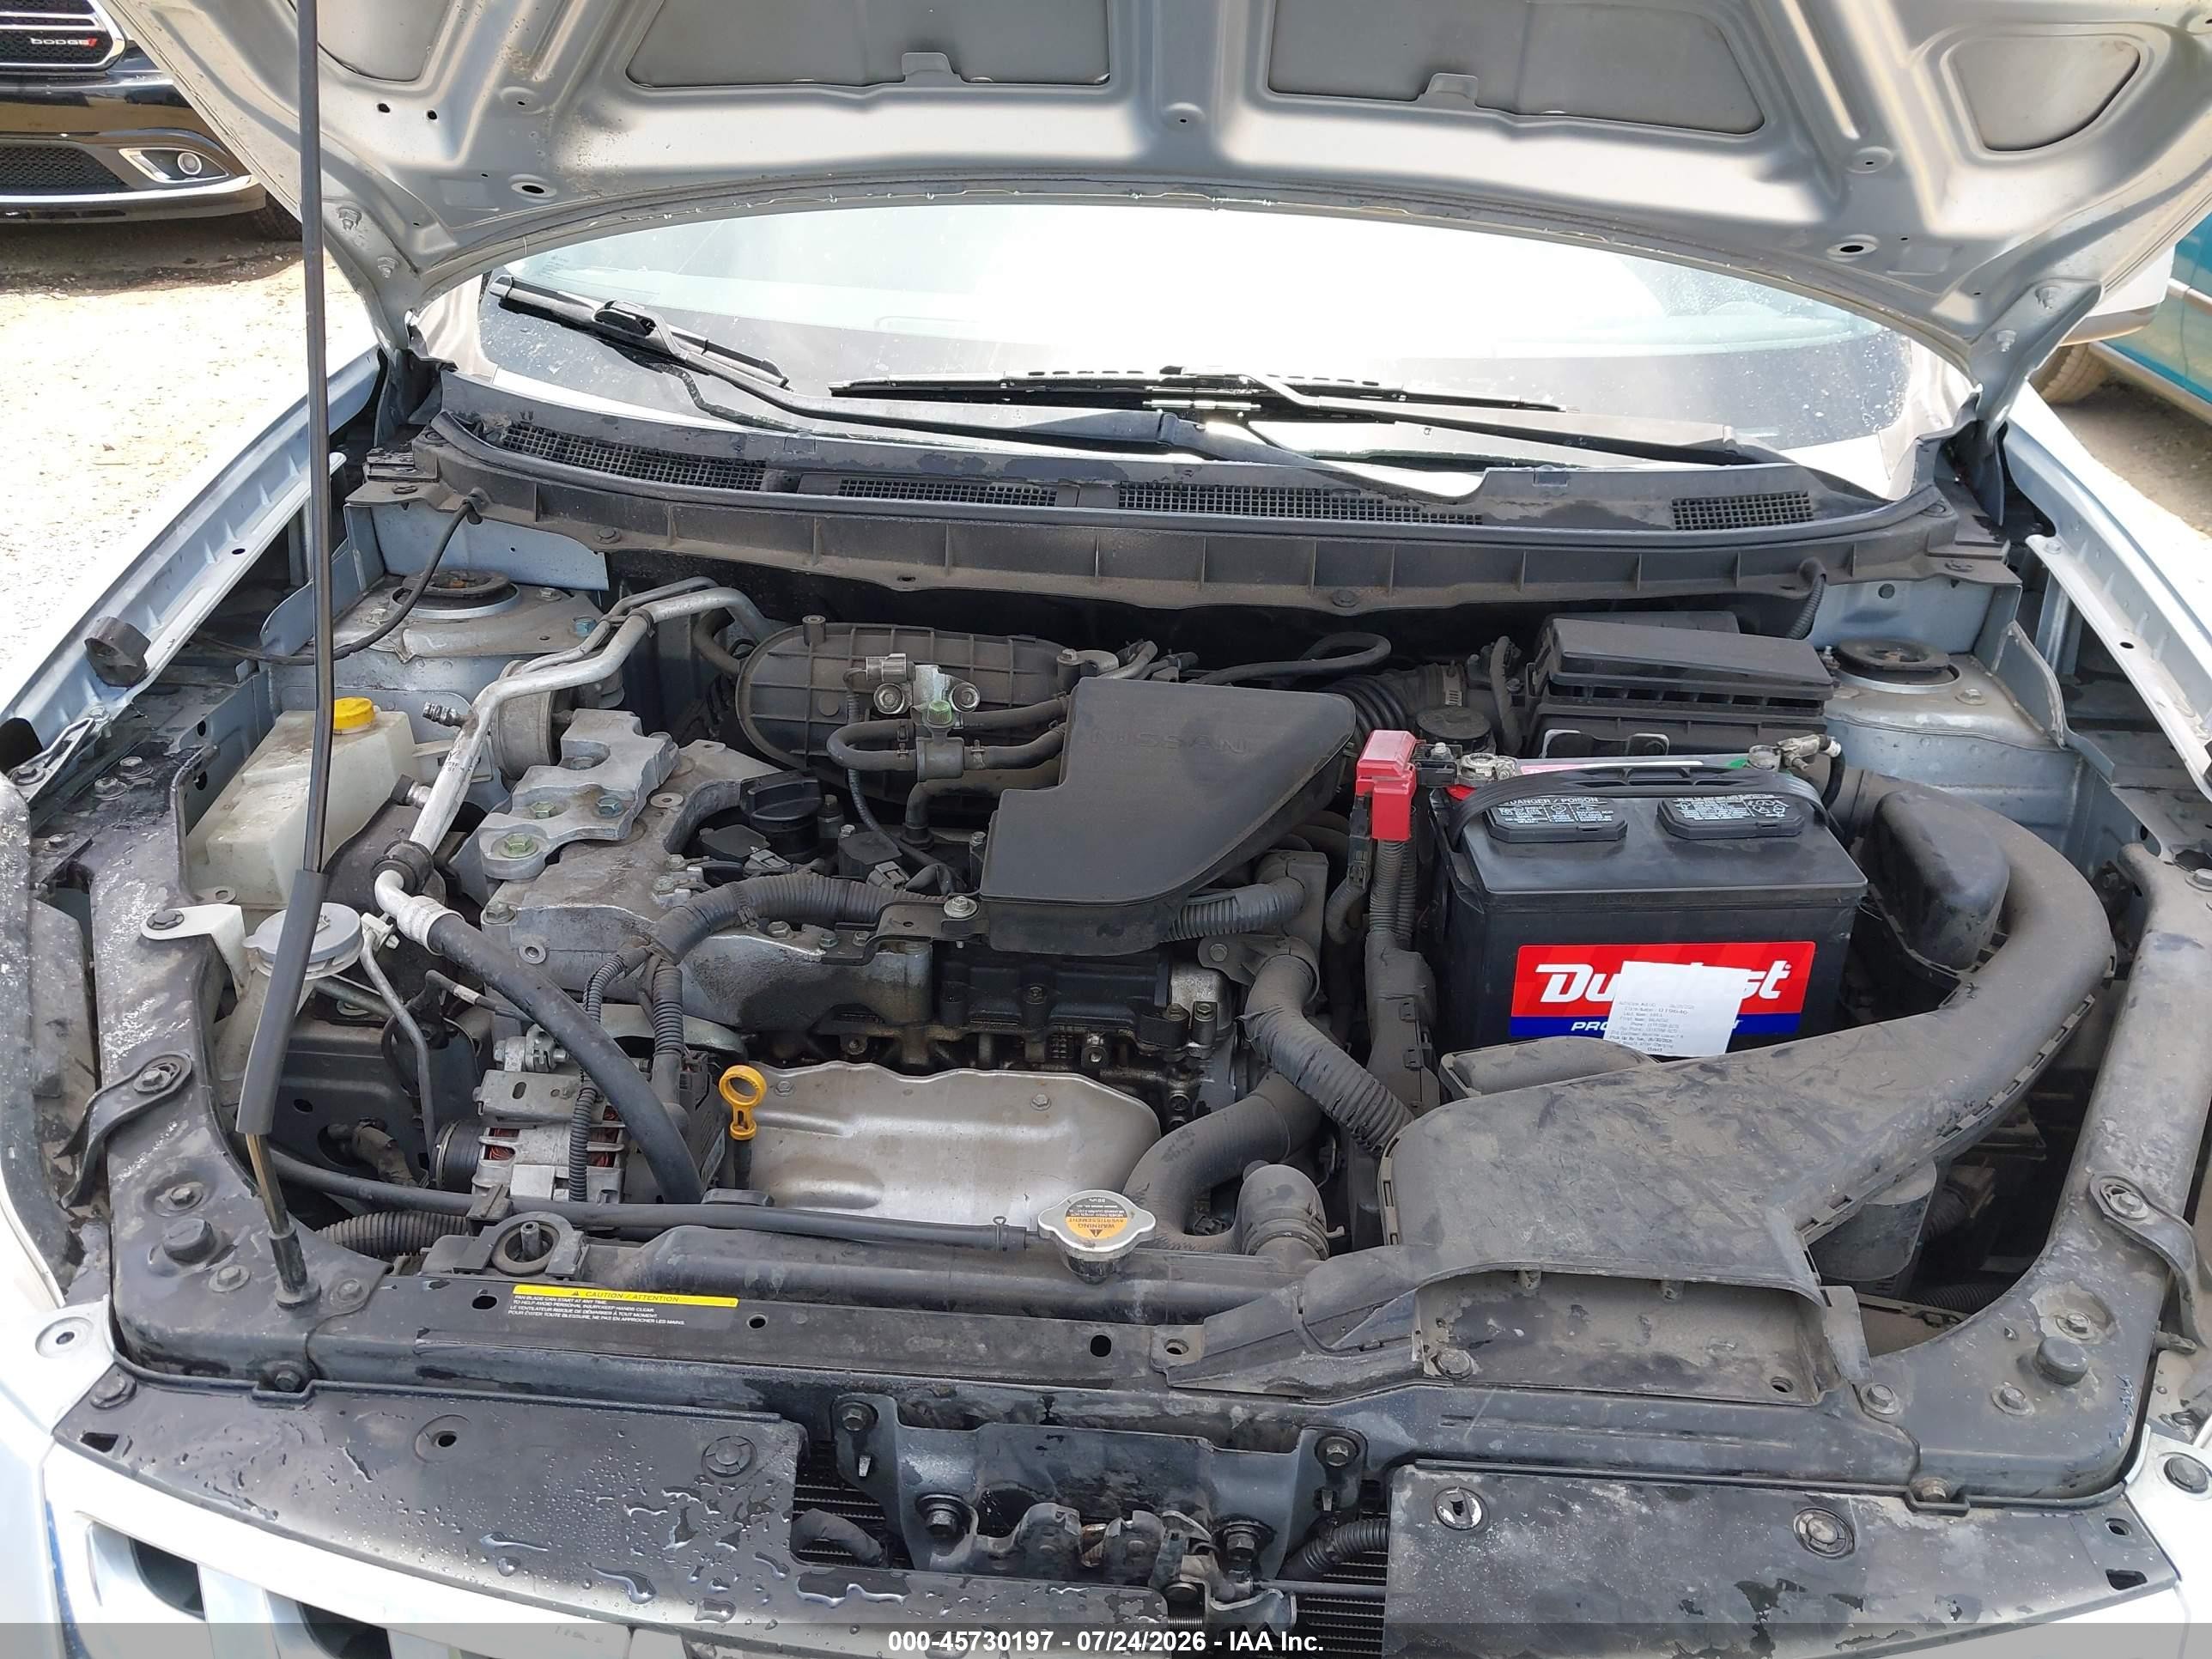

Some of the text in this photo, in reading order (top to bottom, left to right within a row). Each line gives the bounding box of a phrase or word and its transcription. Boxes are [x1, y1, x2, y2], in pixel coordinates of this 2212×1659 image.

[29, 37, 91, 46] DODGE
[585, 1291, 623, 1299] CAUTION
[632, 1294, 679, 1303] ATTENTION
